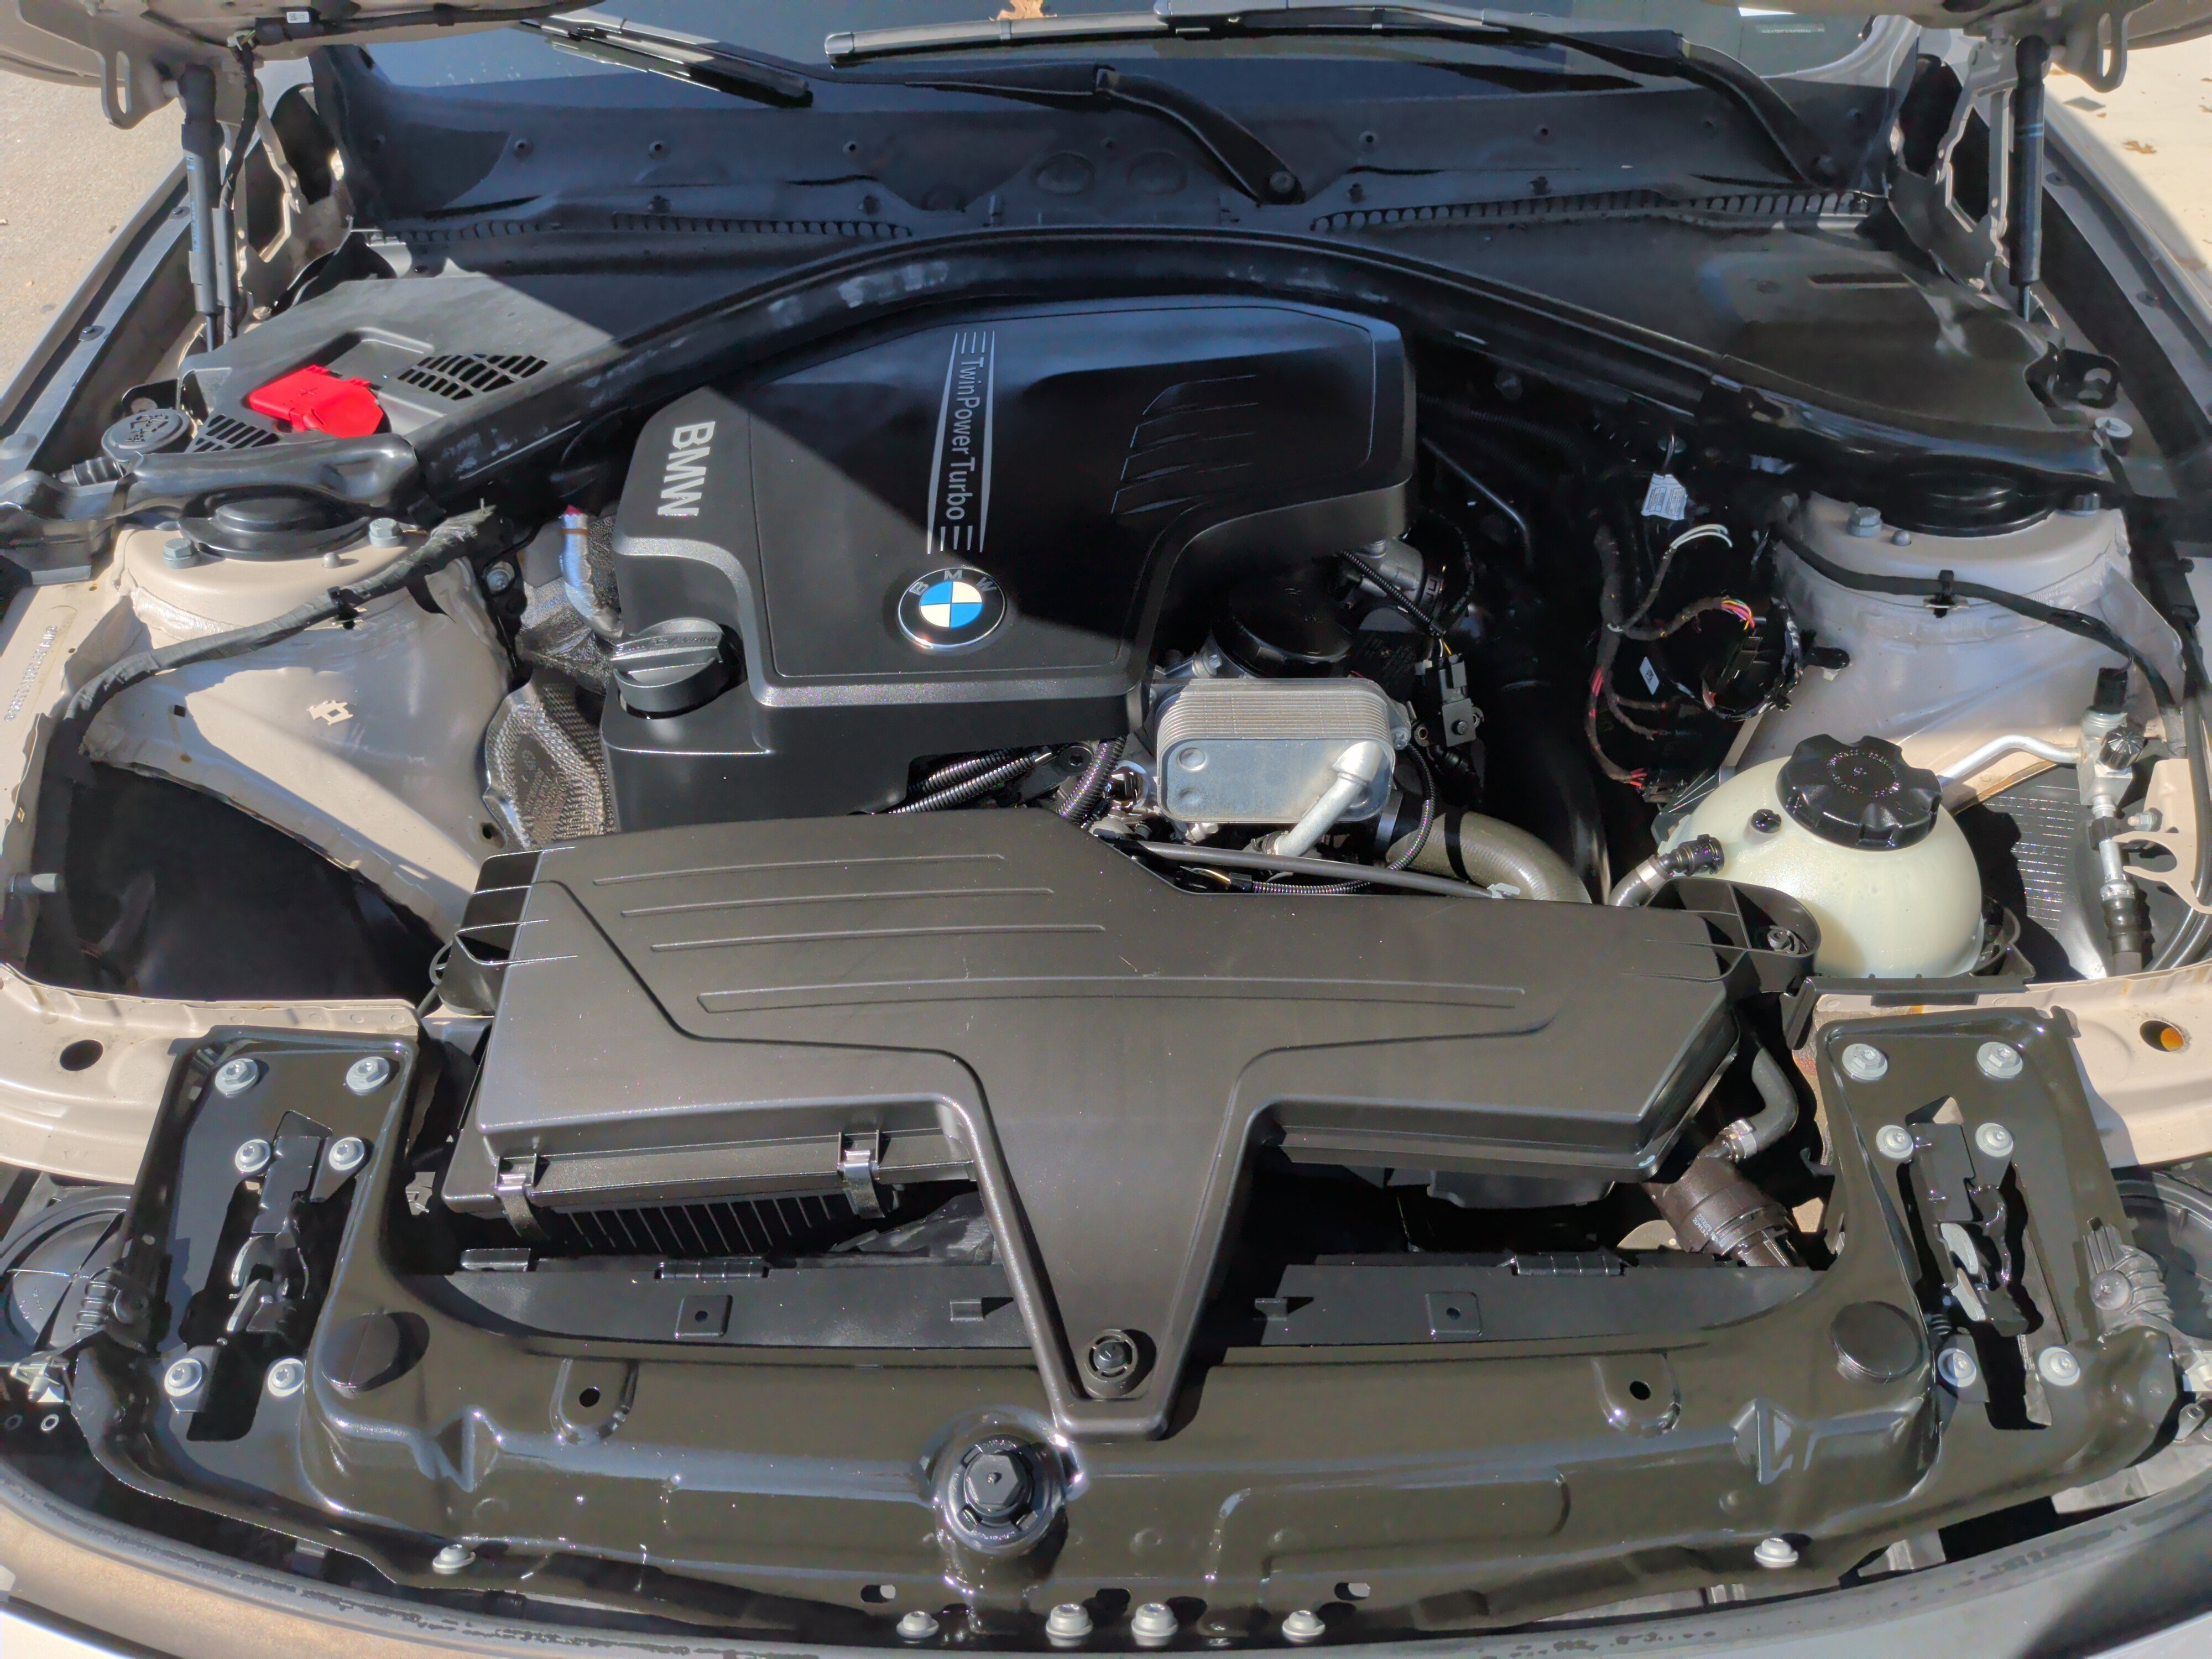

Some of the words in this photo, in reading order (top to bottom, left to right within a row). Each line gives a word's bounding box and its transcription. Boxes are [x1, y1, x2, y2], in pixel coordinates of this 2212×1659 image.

[951, 357, 984, 454] TwinPower
[657, 421, 716, 518] BMW
[946, 457, 975, 520] Turbo
[909, 569, 998, 596] BMW
